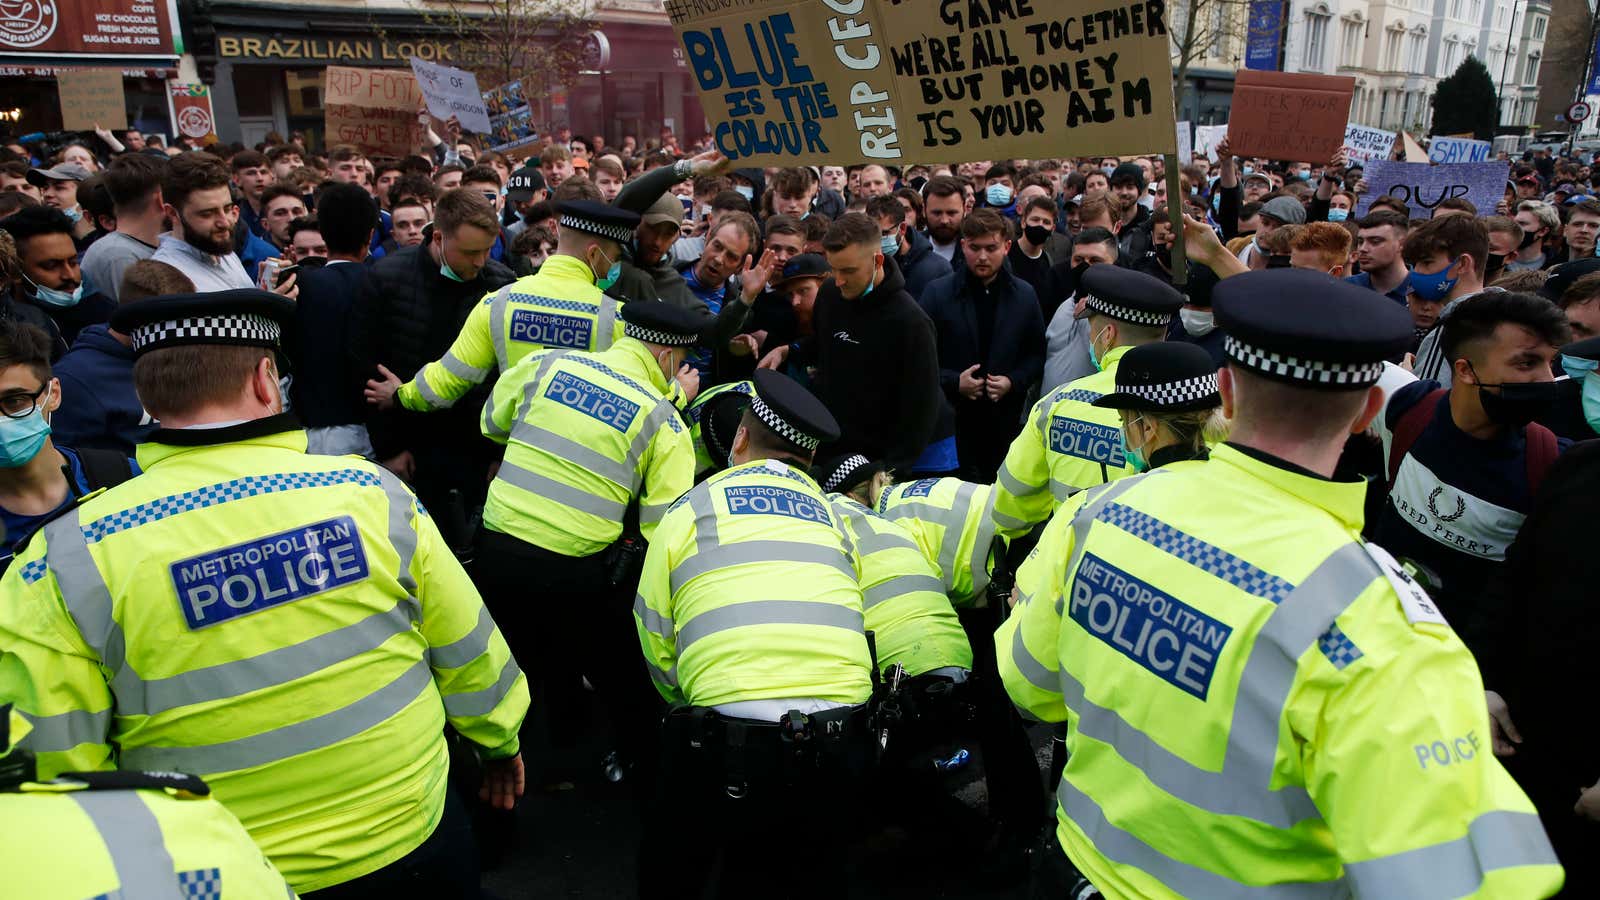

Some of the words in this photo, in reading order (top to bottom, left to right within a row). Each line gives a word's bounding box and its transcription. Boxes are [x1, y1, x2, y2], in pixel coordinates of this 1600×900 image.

[112, 15, 157, 24] CHOCOLATE
[940, 0, 1033, 32] GAME
[0, 25, 48, 42] mpassion
[83, 35, 109, 43] SUGAR
[218, 37, 373, 60] BRAZILIAN
[382, 42, 453, 60] LOOK
[890, 32, 965, 77] WE'RE
[972, 29, 1019, 70] ALL
[1025, 0, 1167, 55] TOGETHER
[682, 12, 814, 91] BLUE
[327, 69, 363, 97] RIP
[920, 72, 983, 105] BUT
[1001, 52, 1119, 98] MONEY
[725, 88, 766, 117] IS
[772, 82, 839, 122] THE
[917, 110, 962, 147] IS
[970, 99, 1045, 139] YOUR
[1066, 77, 1152, 128] AIM
[1300, 93, 1338, 111] YOUR
[338, 123, 390, 142] GAME
[715, 119, 830, 160] COLOUR
[1384, 135, 1394, 145] BY
[1430, 141, 1469, 164] SAY
[513, 322, 588, 347] POLICE
[514, 312, 589, 329] METROPOLITAN
[546, 380, 633, 431] POLICE
[555, 372, 638, 414] METROPOLITAN
[1052, 418, 1120, 441] METROPOLITA
[1050, 429, 1124, 465] POLICE
[728, 496, 832, 526] POLICE
[181, 523, 351, 584] METROPOLITAN
[1432, 524, 1494, 554] PERRY
[187, 542, 361, 621] POLICE
[1079, 557, 1226, 650] METROPOLITAN
[1071, 577, 1213, 693] POLICE
[827, 719, 843, 734] RY
[1414, 730, 1481, 769] POCE
